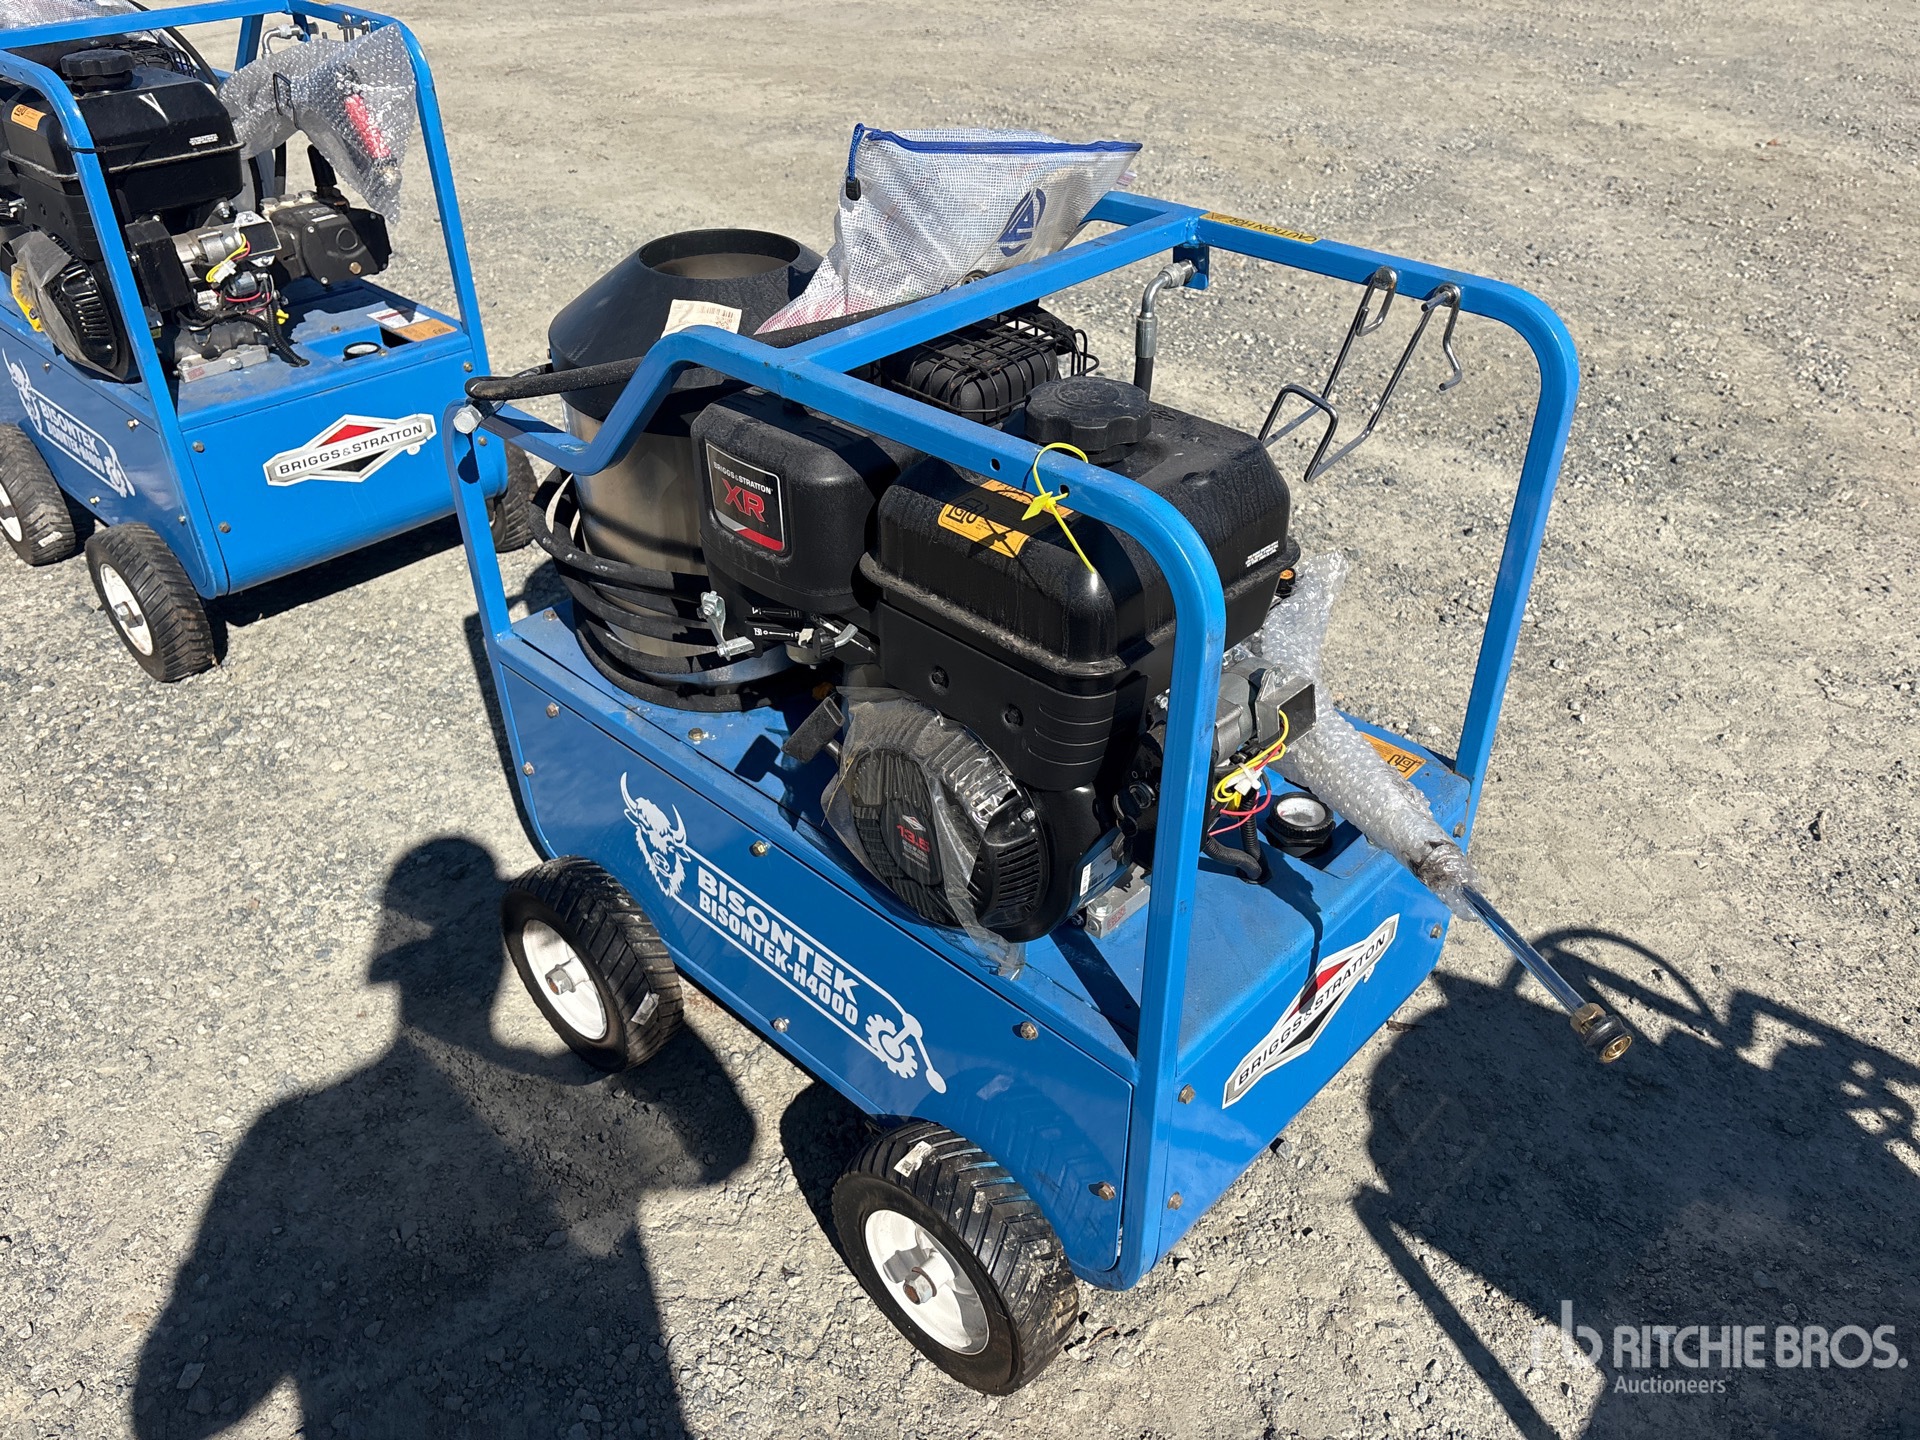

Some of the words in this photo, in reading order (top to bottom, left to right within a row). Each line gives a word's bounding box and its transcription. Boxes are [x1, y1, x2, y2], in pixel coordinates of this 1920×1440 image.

[1253, 224, 1318, 242] CAUTION
[39, 400, 100, 456] BISONTEK
[722, 478, 765, 522] XR
[896, 824, 930, 853] 13.5
[698, 866, 859, 1005] BISONTEK
[699, 890, 859, 1026] BISONTEK-H4000
